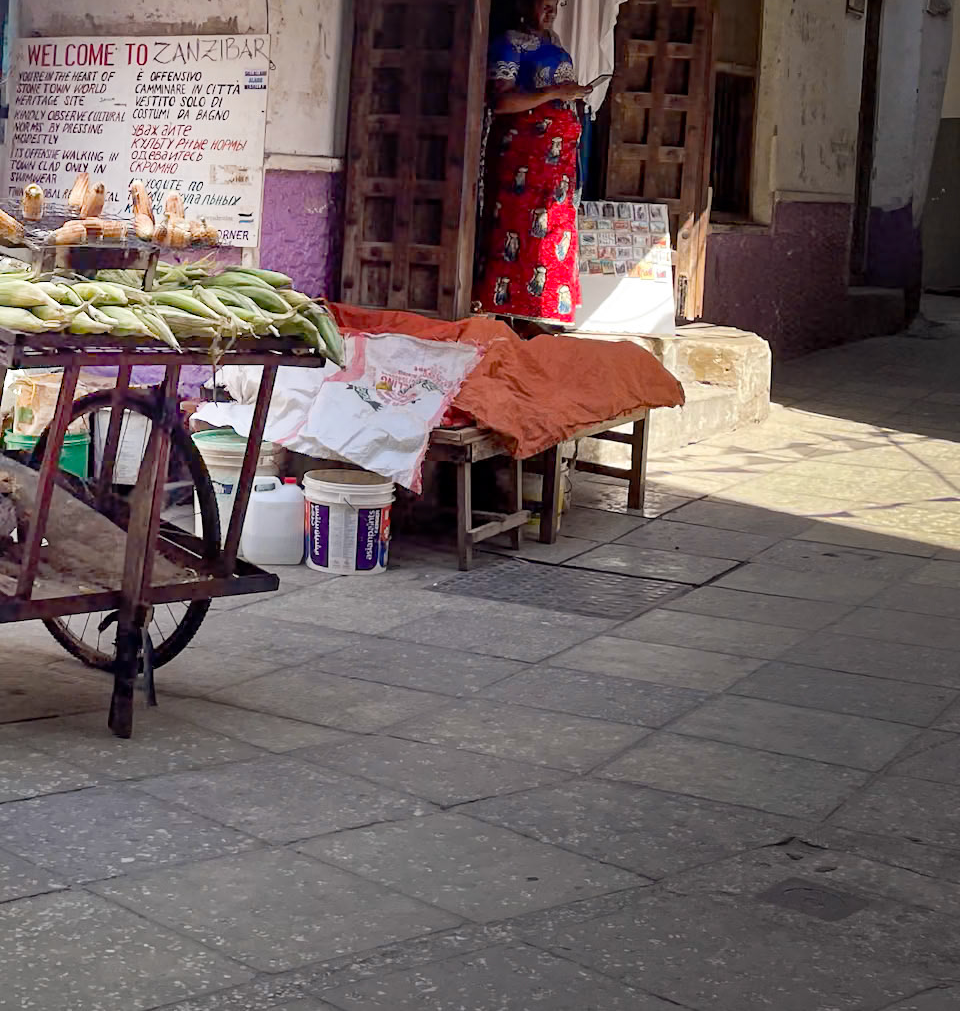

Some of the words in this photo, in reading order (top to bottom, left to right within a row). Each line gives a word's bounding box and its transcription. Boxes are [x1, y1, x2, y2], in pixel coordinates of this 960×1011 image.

[28, 44, 116, 66] WELCOME
[125, 43, 148, 65] TO
[153, 37, 270, 64] ZANZIBAR
[54, 72, 70, 81] THE
[72, 71, 98, 82] HEART
[101, 71, 115, 82] OF
[150, 72, 202, 81] OFFENSIVO
[17, 83, 40, 94] STONE
[43, 84, 71, 94] TOWN
[74, 84, 106, 94] WORLD
[135, 85, 186, 95] CAMMINARE
[192, 85, 201, 95] IN
[206, 80, 240, 95] CITTÀ
[16, 95, 58, 106] HERITAGE
[64, 95, 85, 106] SITE
[135, 96, 176, 107] VESTITO
[180, 97, 206, 107] SOLO
[211, 97, 223, 107] DI
[14, 109, 46, 120] KINDLY
[48, 111, 88, 121] OBSERVE
[88, 111, 125, 122] CULTURAL
[132, 109, 170, 119] COSTUMI
[178, 109, 189, 119] DA
[196, 109, 230, 120] BAGNO
[15, 122, 44, 132] NORMS
[49, 123, 60, 132] BY
[62, 124, 103, 134] DRESSING
[13, 134, 58, 144] MODESTLY
[24, 149, 60, 160] OFFENSIVE
[62, 150, 104, 161] WALKING
[109, 152, 119, 161] IN
[10, 160, 36, 170] TOWN
[39, 161, 60, 171] CLAD
[65, 162, 89, 173] ONLY
[94, 164, 107, 174] IN
[10, 172, 57, 184] SWIMWEAR
[9, 187, 24, 196] THIN
[217, 230, 249, 240] ORNER
[365, 510, 375, 560] asianpaints
